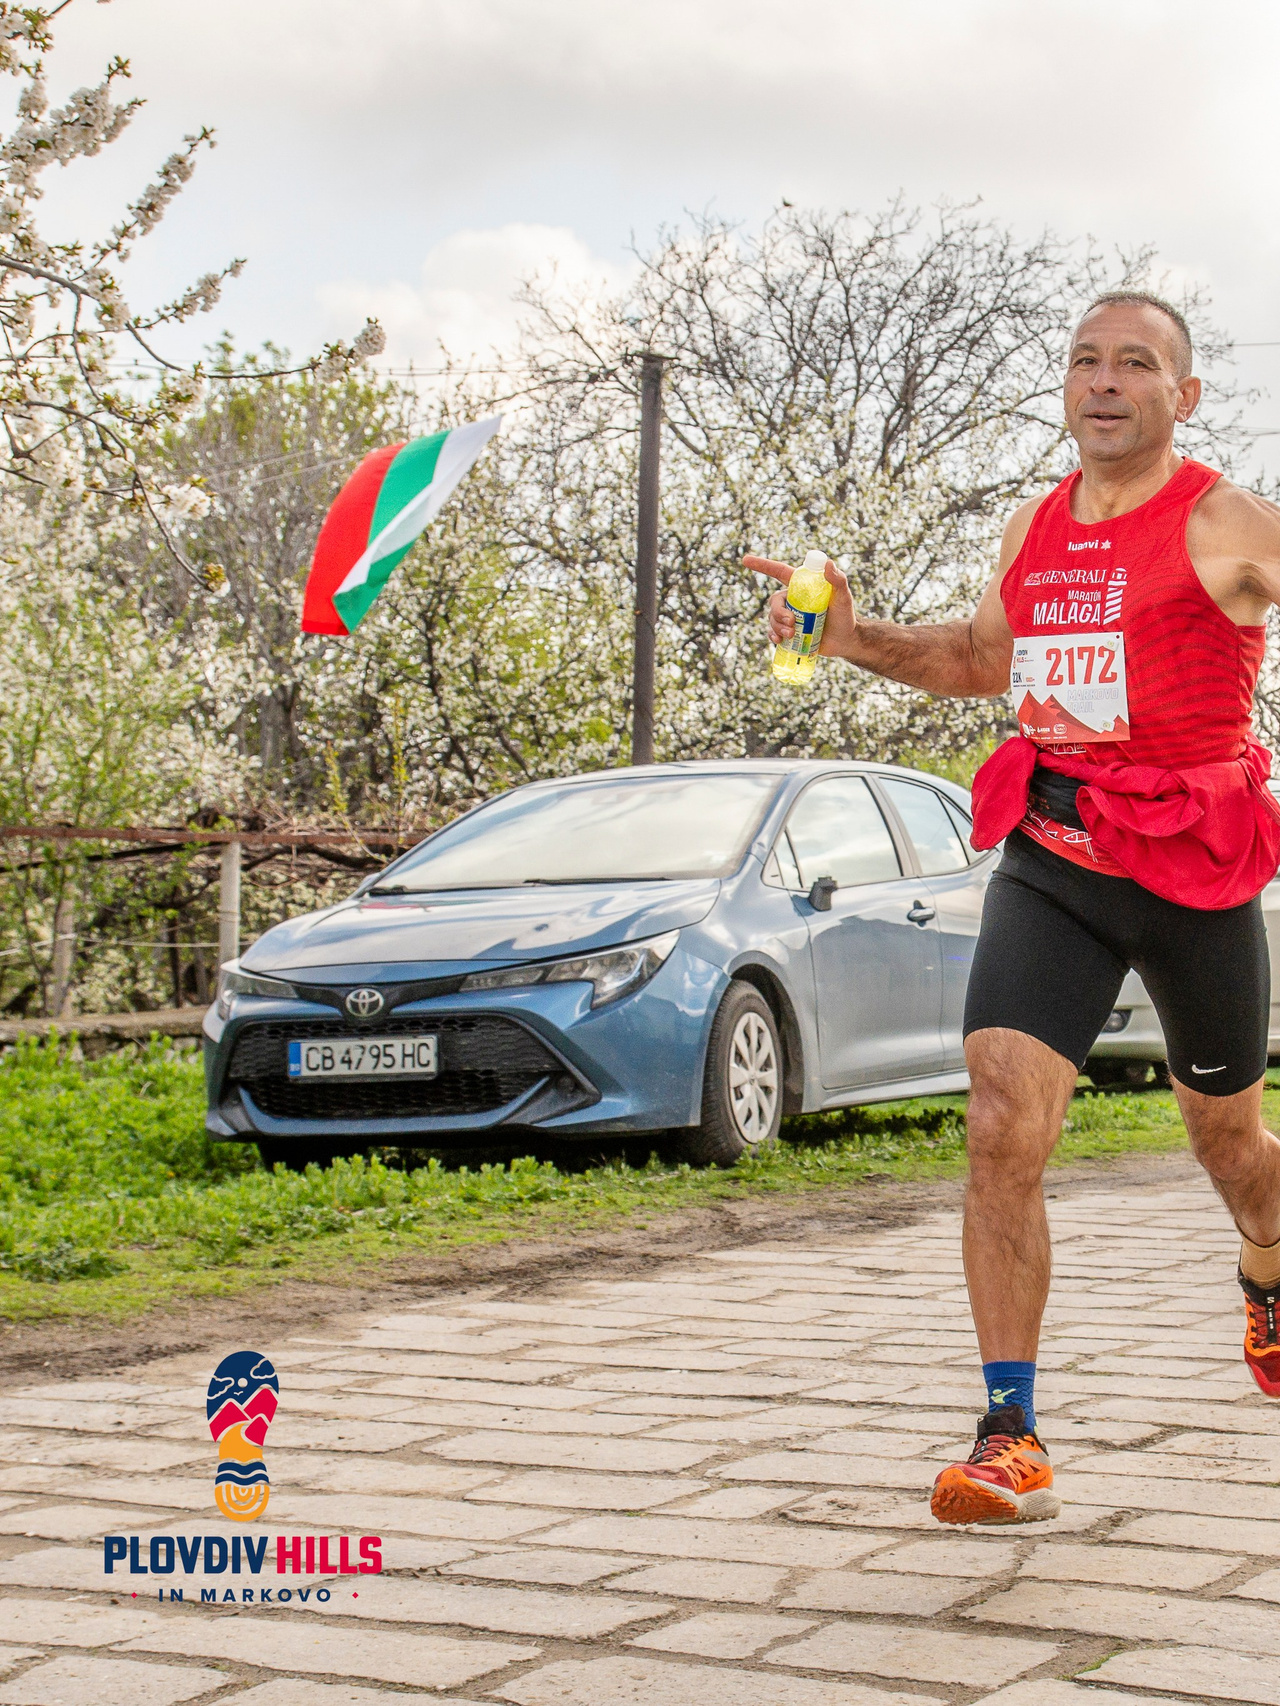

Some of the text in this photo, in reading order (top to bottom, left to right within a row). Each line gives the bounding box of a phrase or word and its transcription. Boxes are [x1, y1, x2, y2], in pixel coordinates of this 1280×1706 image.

[1042, 569, 1107, 584] GENERALI
[1033, 598, 1101, 626] MÁLAGA
[1045, 646, 1119, 686] 2172
[1067, 688, 1119, 701] MARKOVO
[306, 1042, 430, 1071] CB 4795 HC
